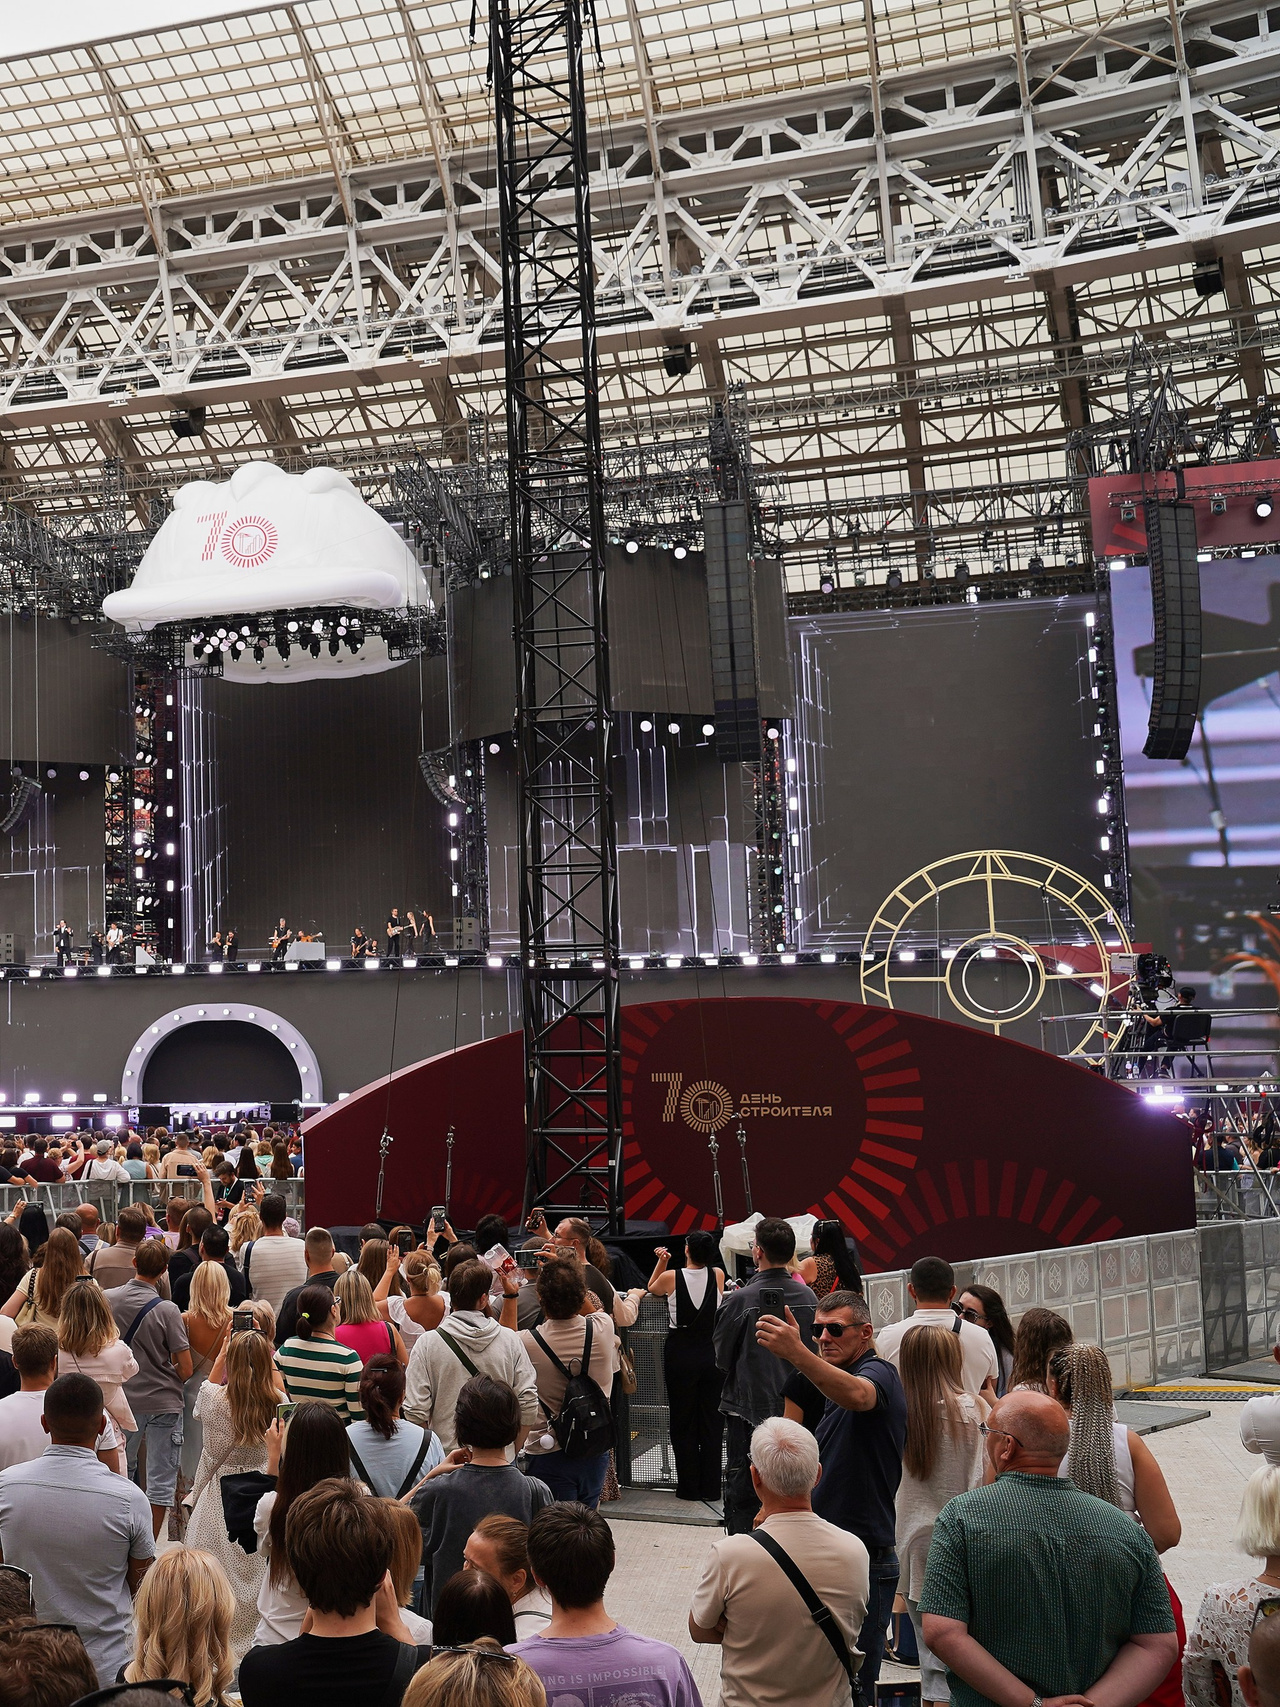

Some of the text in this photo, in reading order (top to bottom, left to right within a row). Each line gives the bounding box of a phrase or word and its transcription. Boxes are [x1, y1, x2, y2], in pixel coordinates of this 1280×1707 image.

[740, 1093, 782, 1104] ДЕНЬ
[740, 1106, 833, 1117] СТРОИТЕЛЯ
[570, 1674, 583, 1684] IS
